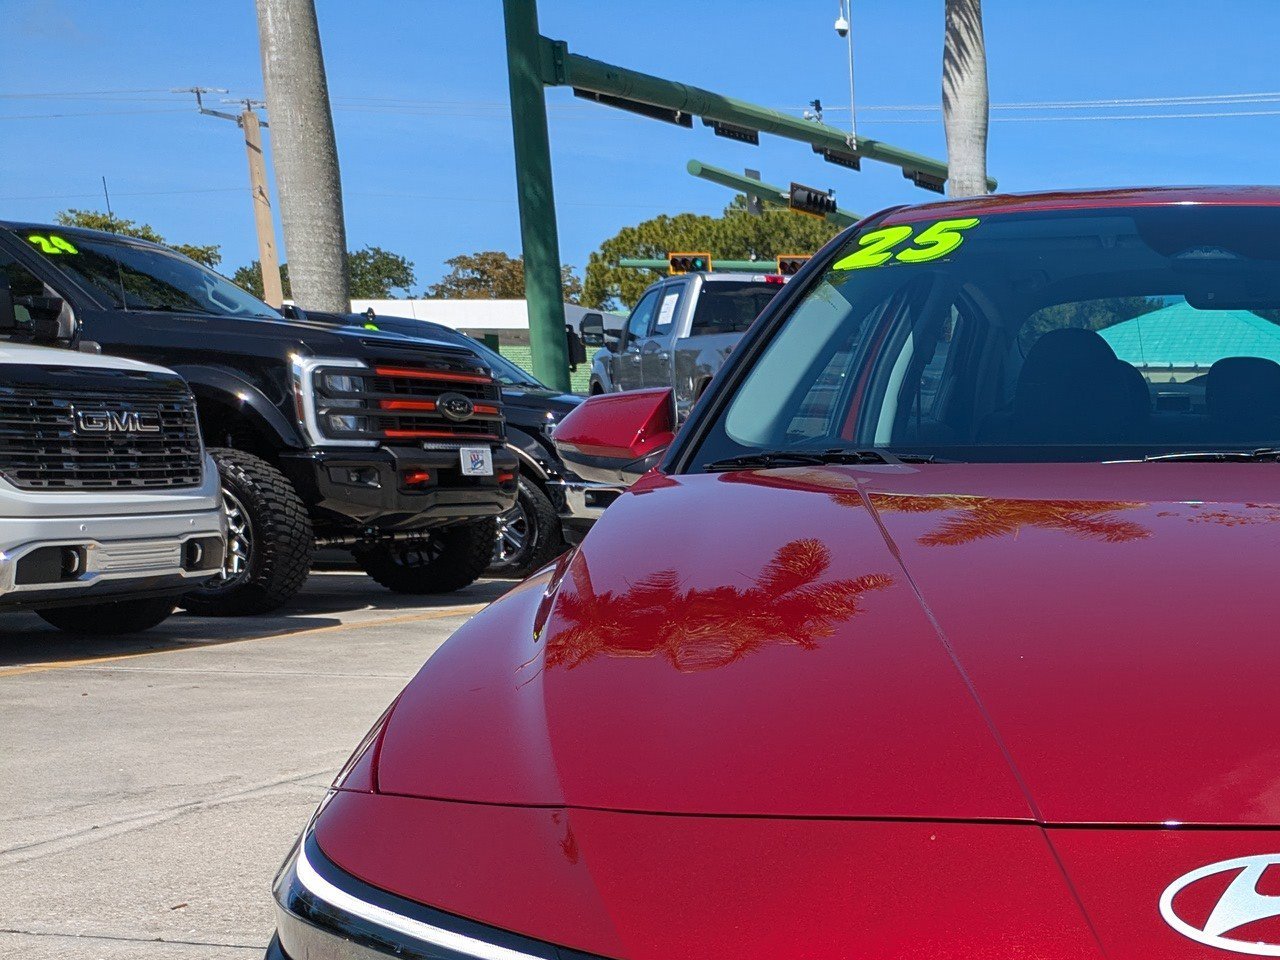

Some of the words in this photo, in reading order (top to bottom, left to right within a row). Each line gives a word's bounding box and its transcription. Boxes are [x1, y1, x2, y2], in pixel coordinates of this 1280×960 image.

[28, 235, 78, 254] 24
[832, 218, 980, 270] 25
[78, 410, 160, 432] GMC
